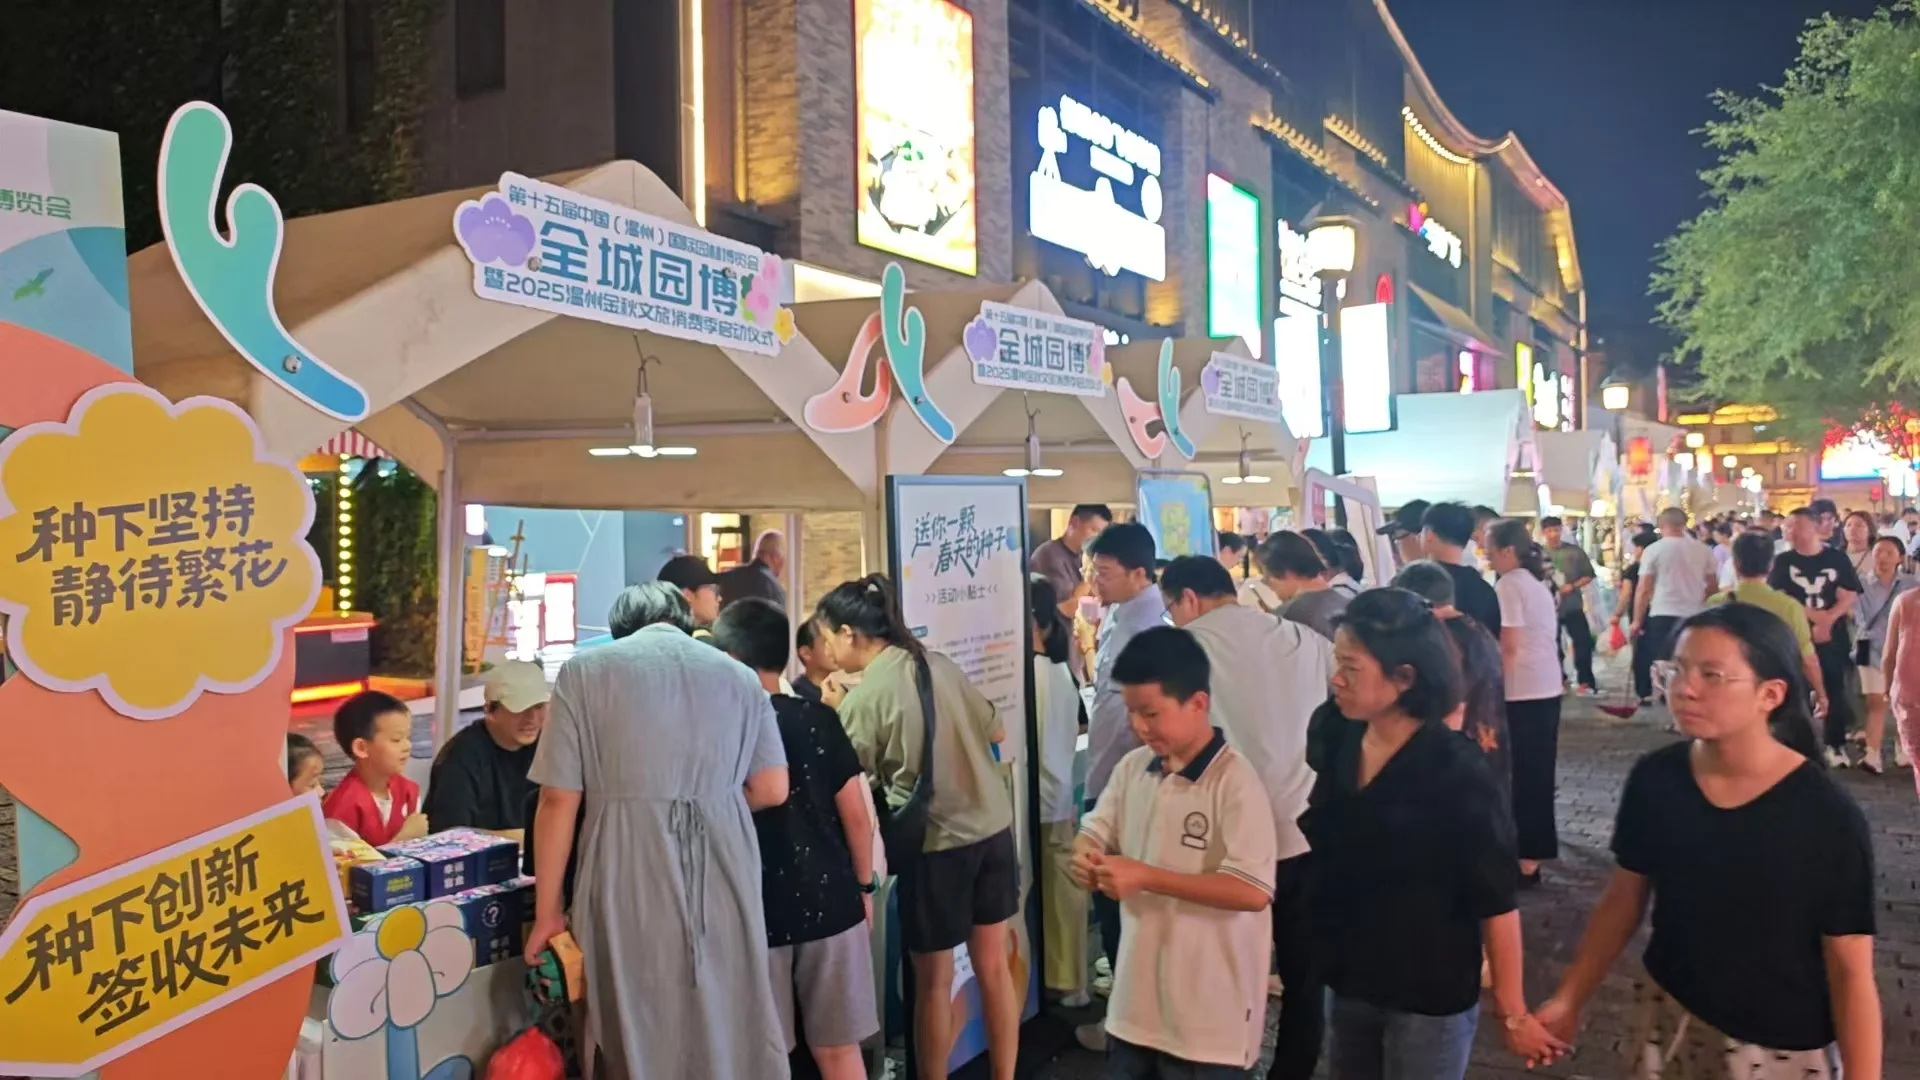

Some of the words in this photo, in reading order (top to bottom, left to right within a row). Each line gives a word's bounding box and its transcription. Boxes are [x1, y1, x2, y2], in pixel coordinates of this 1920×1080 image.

[539, 220, 738, 317] 全城园博
[999, 328, 1085, 374] 全城园博
[16, 483, 255, 563] 种下坚持
[911, 504, 977, 558] 送你一颗
[934, 526, 1006, 579] 春天的种子
[51, 539, 288, 627] 静待繁花
[5, 833, 259, 1005] 种下创新
[78, 879, 325, 1037] 签收未来
